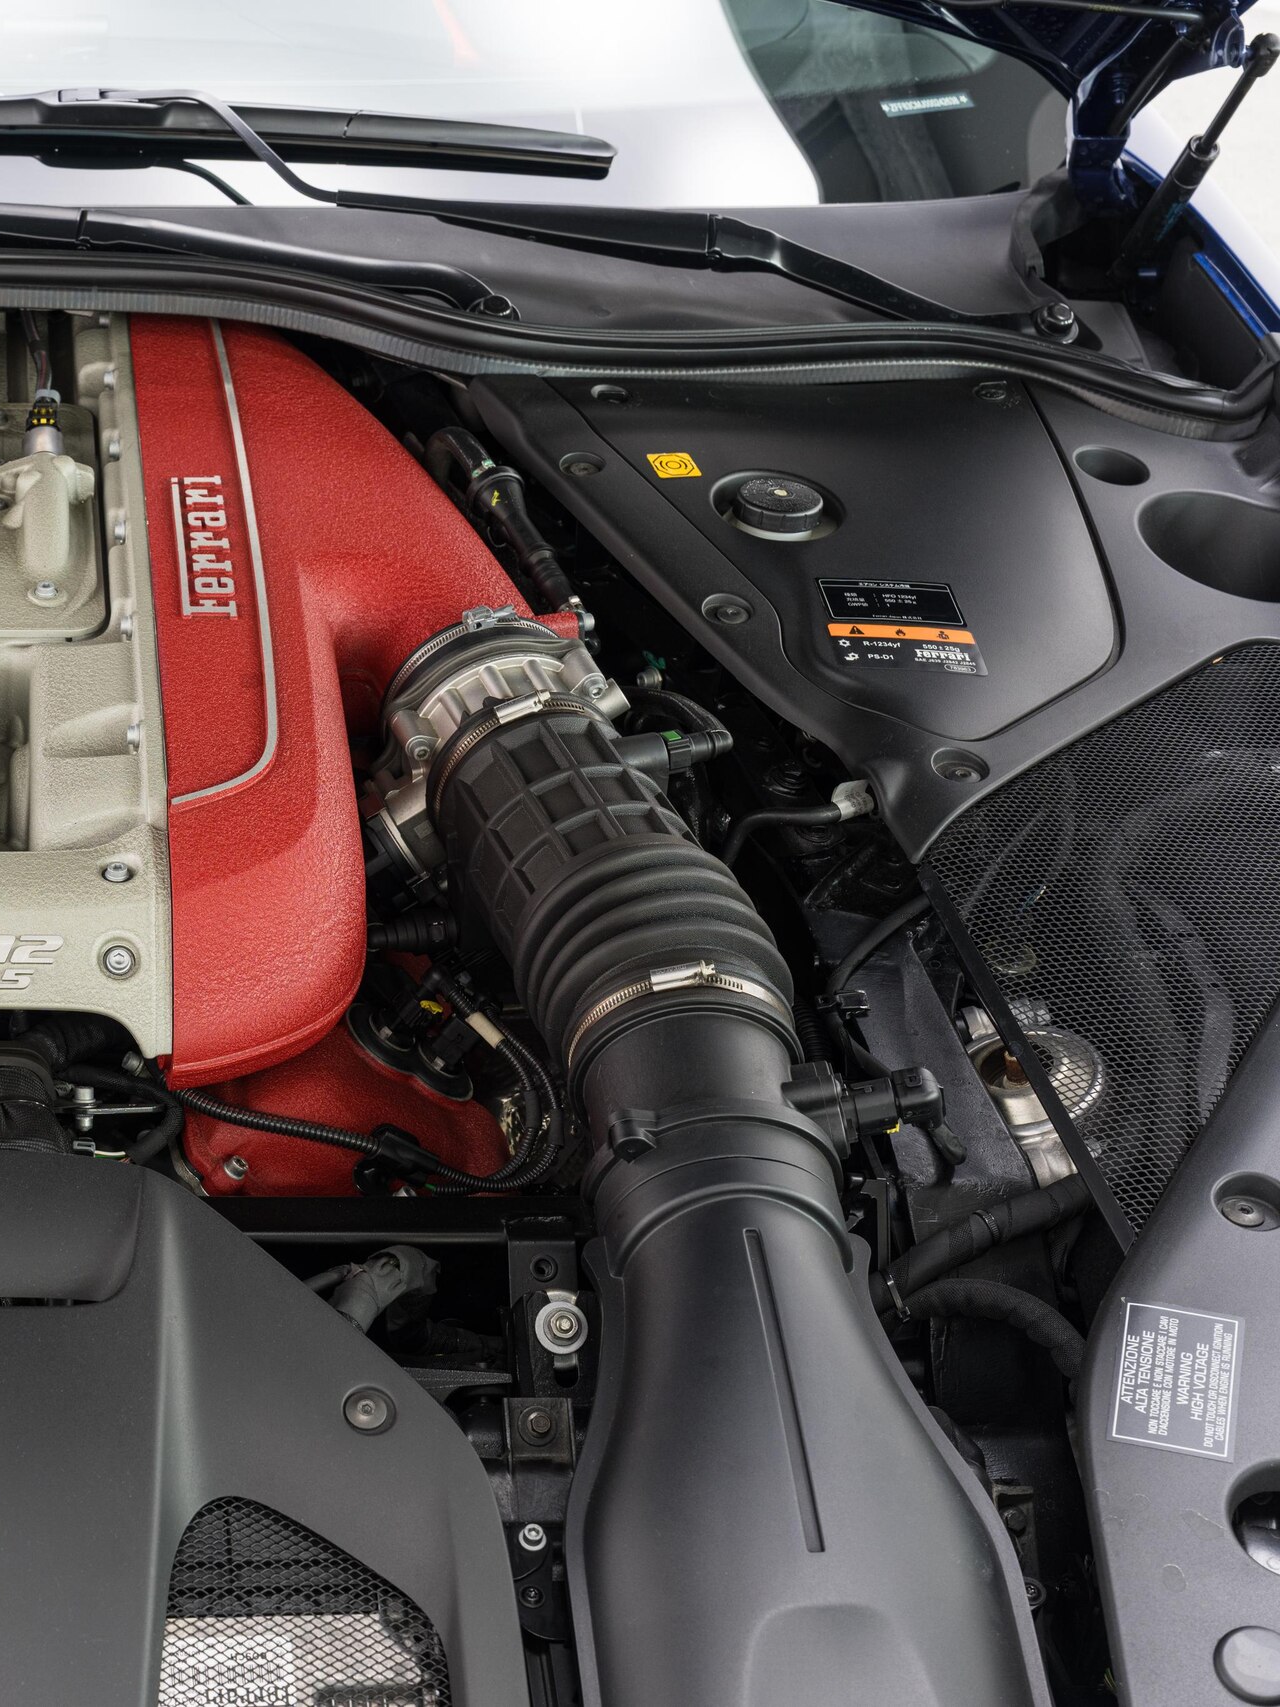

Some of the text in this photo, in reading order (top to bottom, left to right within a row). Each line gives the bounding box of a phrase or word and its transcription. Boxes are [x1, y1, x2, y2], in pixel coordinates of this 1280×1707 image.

[171, 476, 238, 618] Ferrari
[914, 649, 970, 661] Ferrari
[1159, 1315, 1169, 1330] CAVI
[1168, 1317, 1178, 1337] MOTO
[1155, 1334, 1167, 1366] STACCARE
[1165, 1346, 1176, 1373] MOTORE
[1222, 1332, 1233, 1361] RUNNING
[1121, 1334, 1140, 1404] ATTENZIONE
[1135, 1330, 1154, 1413] ALTA TENSIONE
[1154, 1366, 1163, 1382] NON
[1163, 1373, 1173, 1388] CON
[1176, 1351, 1193, 1406] WARNING
[1190, 1342, 1209, 1421] HIGH VOLTAGE
[1219, 1370, 1229, 1394] ENGINE
[1203, 1323, 1224, 1447] DO NOT TOUCH OR DISCONNECT IGNITION
[1150, 1388, 1161, 1417] TOCCARE
[1158, 1389, 1171, 1435] D'ACCENSIONE
[1217, 1395, 1227, 1415] WHEN
[1148, 1418, 1158, 1434] NON
[1214, 1416, 1225, 1440] CABLES
